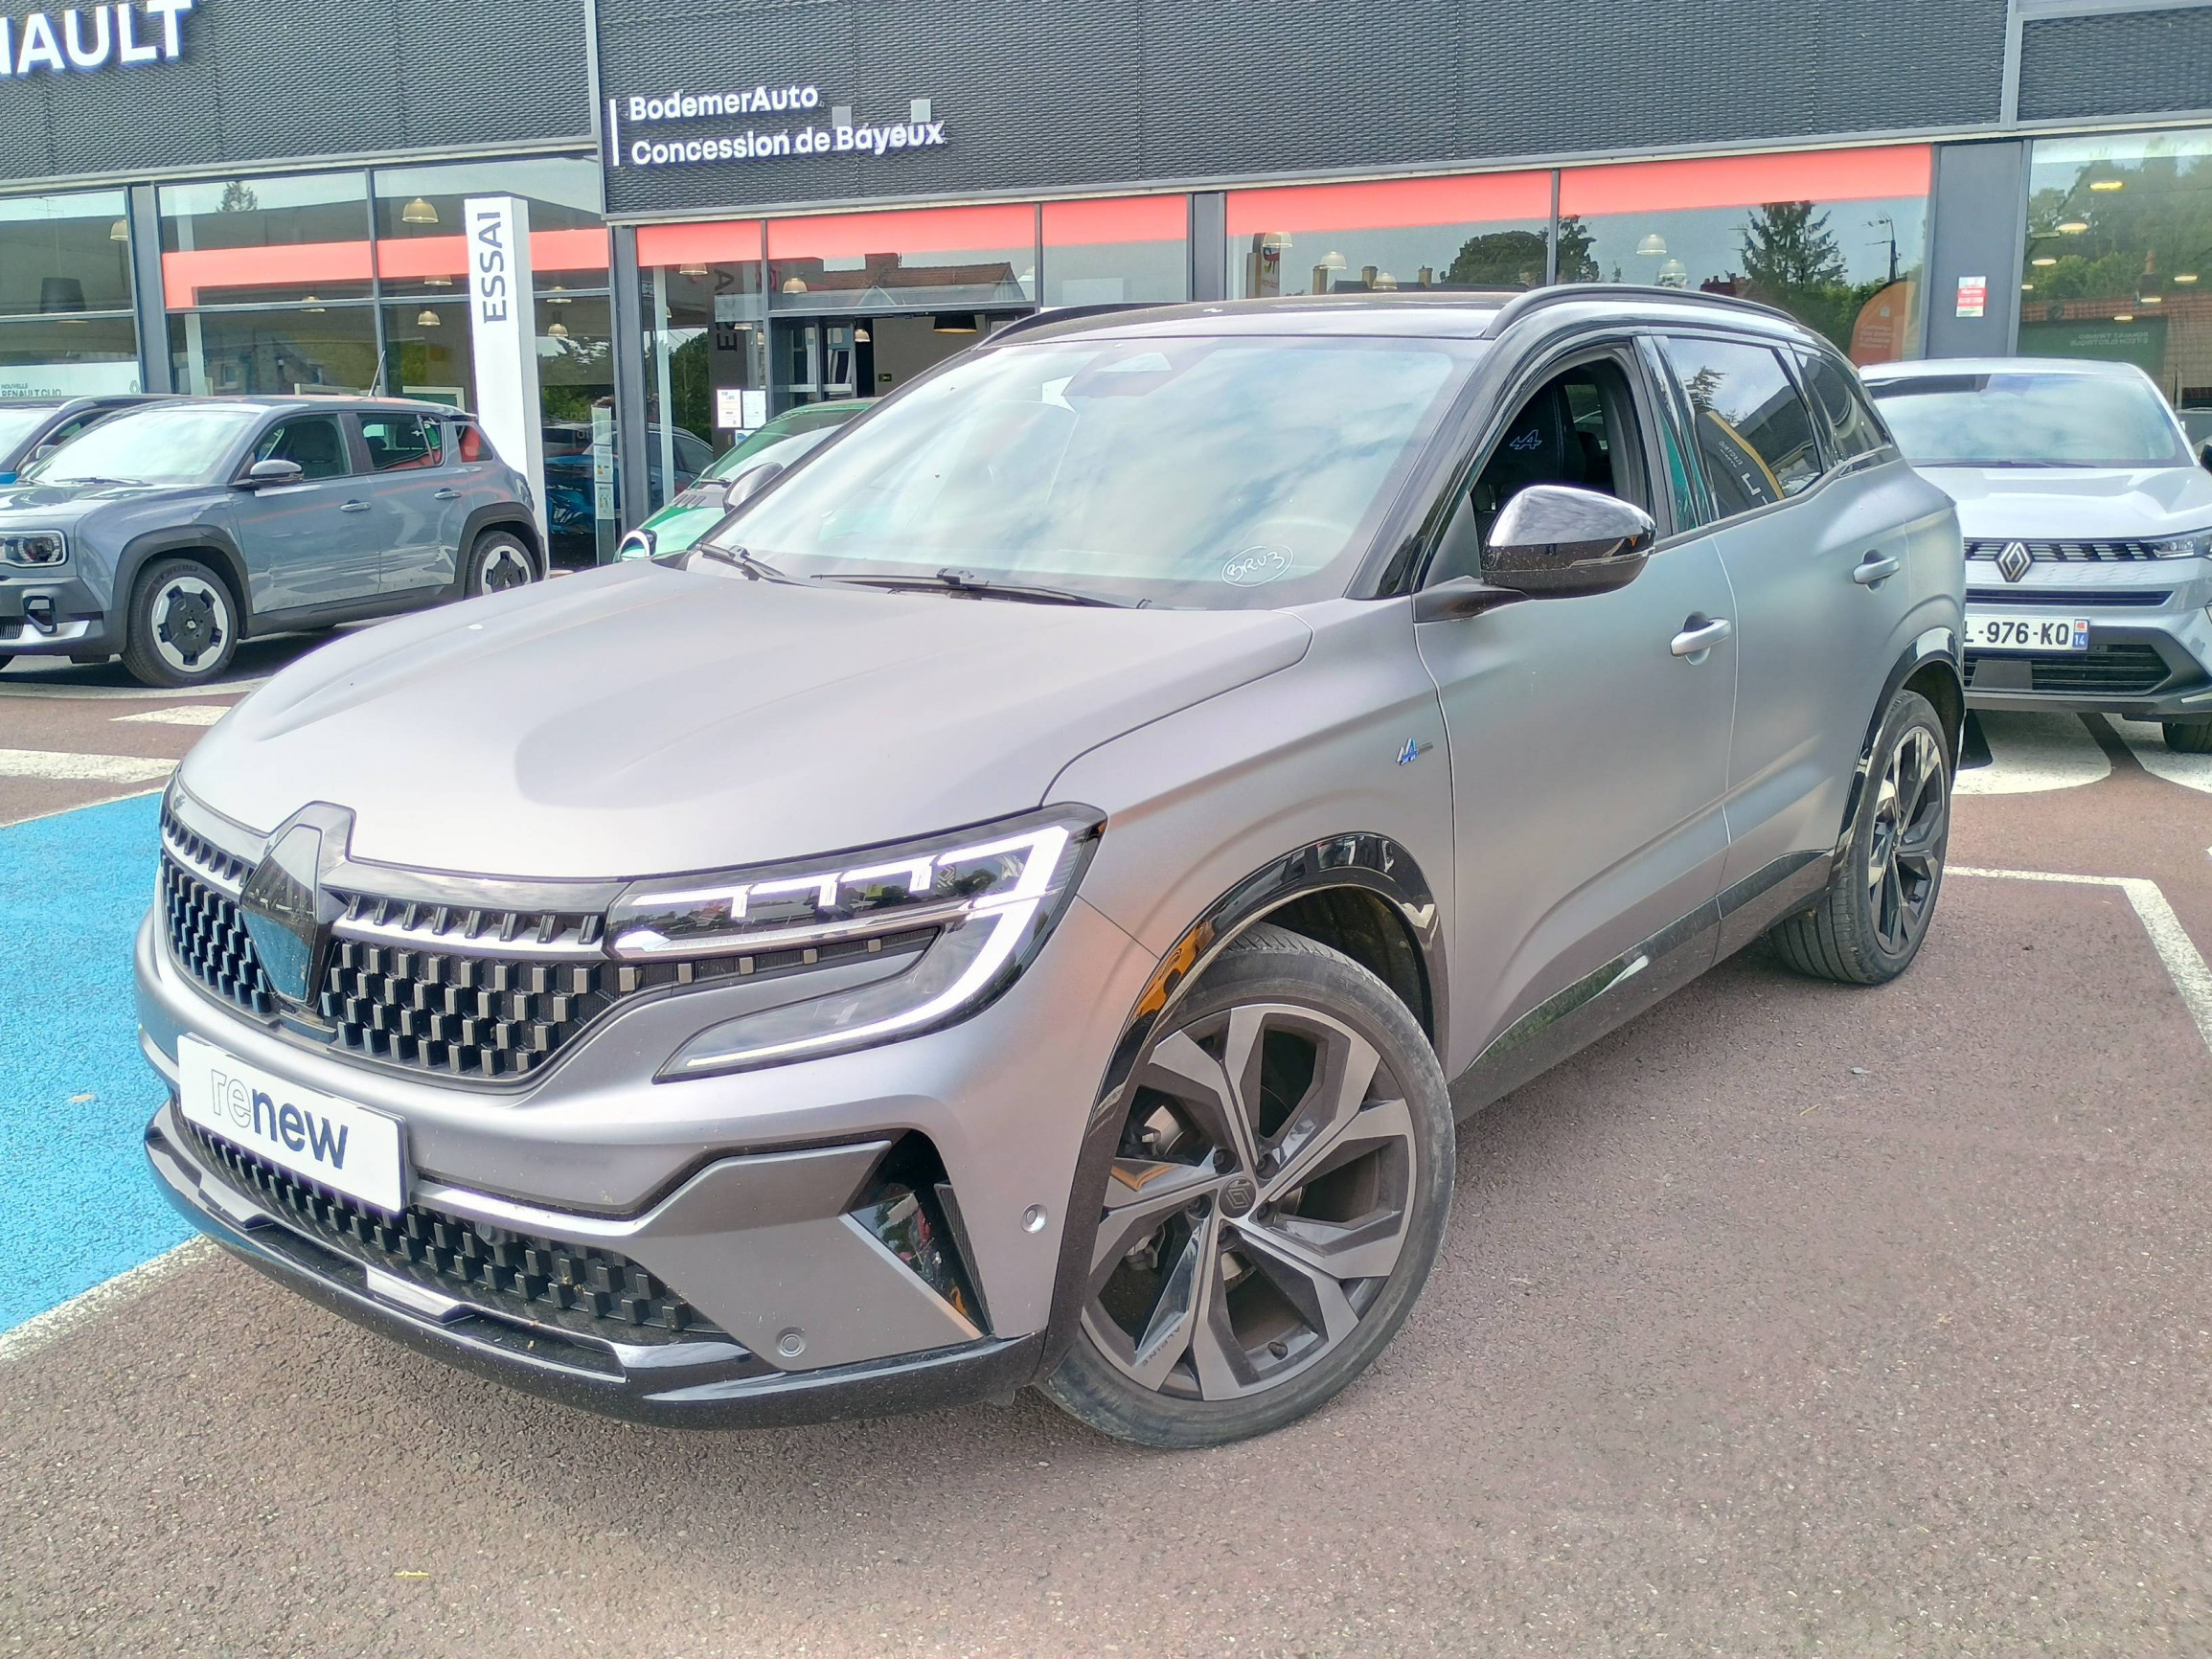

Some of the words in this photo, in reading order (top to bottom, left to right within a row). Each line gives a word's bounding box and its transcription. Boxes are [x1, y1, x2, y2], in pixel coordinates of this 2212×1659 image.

[0, 0, 193, 76] AULT
[629, 84, 819, 122] BodemerAuto
[631, 130, 790, 165] Concession
[796, 127, 831, 153] de
[836, 121, 946, 155] Bayeux
[477, 212, 508, 324] ESSAI
[2074, 634, 2086, 646] 14
[211, 1068, 349, 1170] renew
